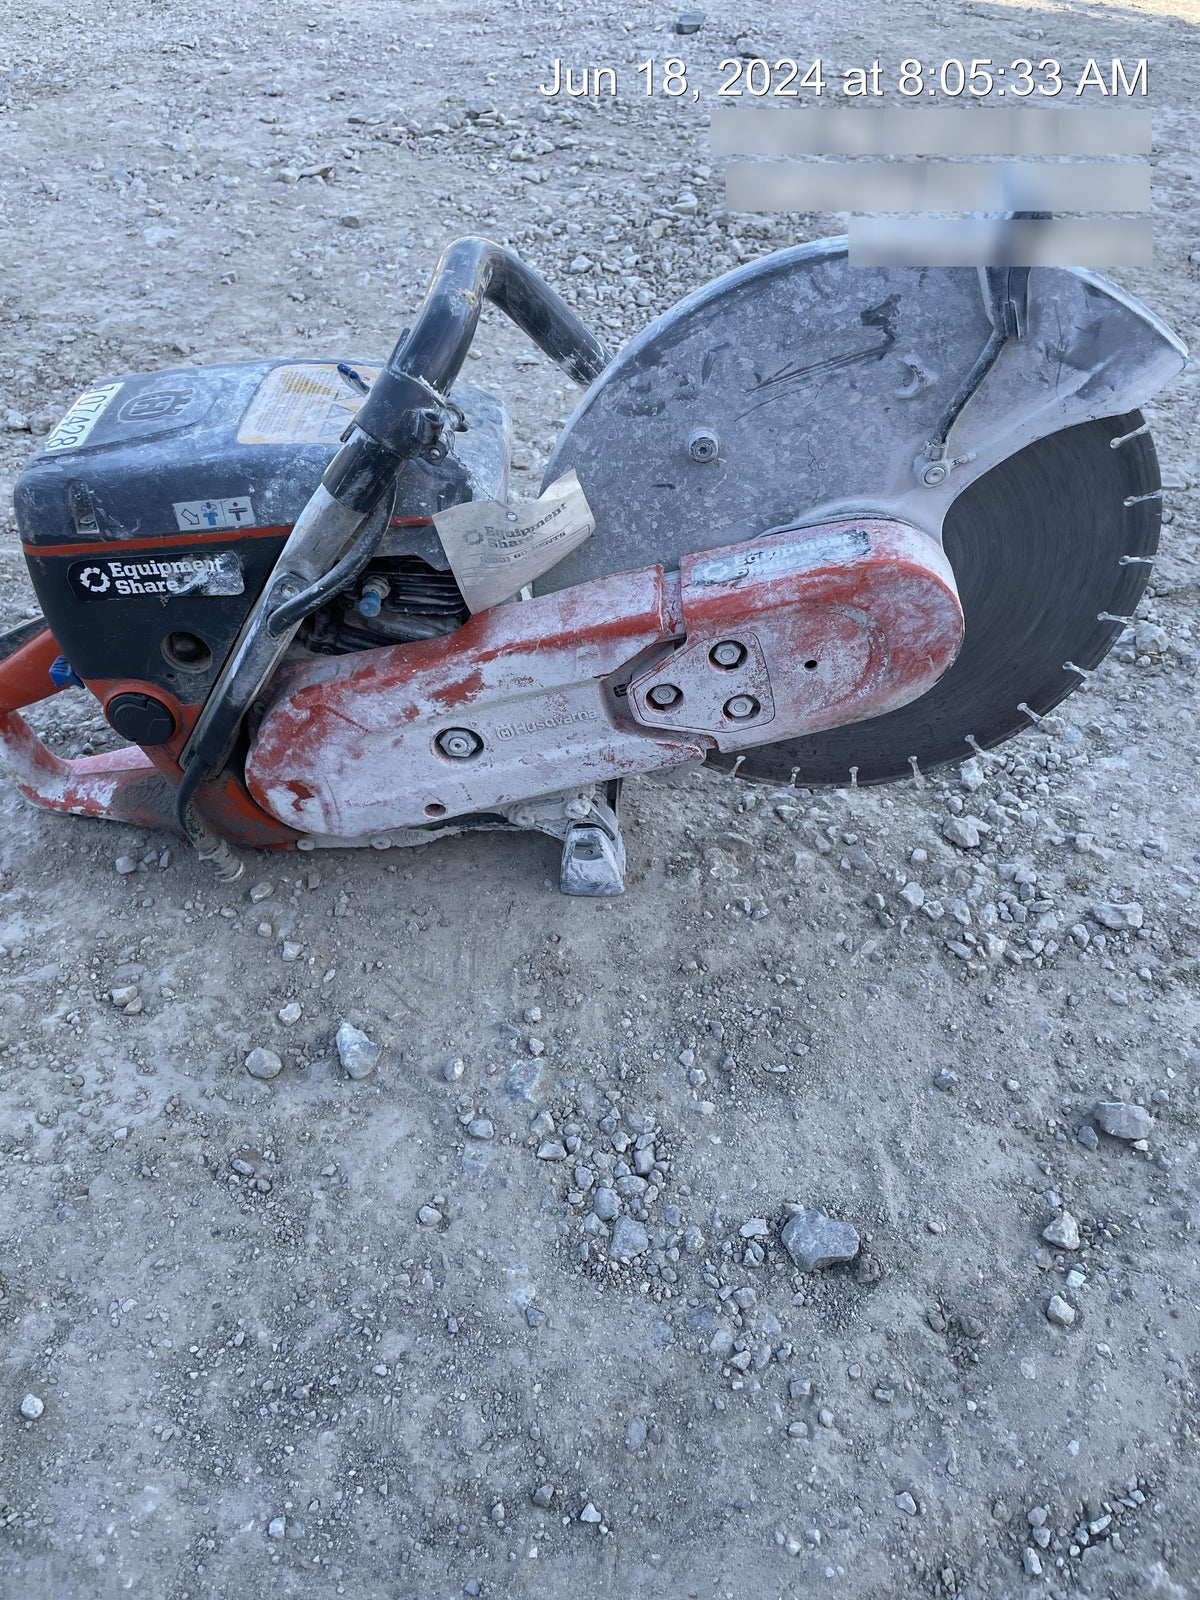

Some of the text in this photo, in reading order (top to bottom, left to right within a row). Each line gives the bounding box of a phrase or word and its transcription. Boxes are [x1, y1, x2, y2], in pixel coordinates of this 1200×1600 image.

[51, 383, 118, 450] 107428
[484, 502, 567, 540] Equipment
[108, 557, 224, 579] Equipment
[114, 578, 181, 595] Share
[515, 711, 597, 735] Husqvarna
